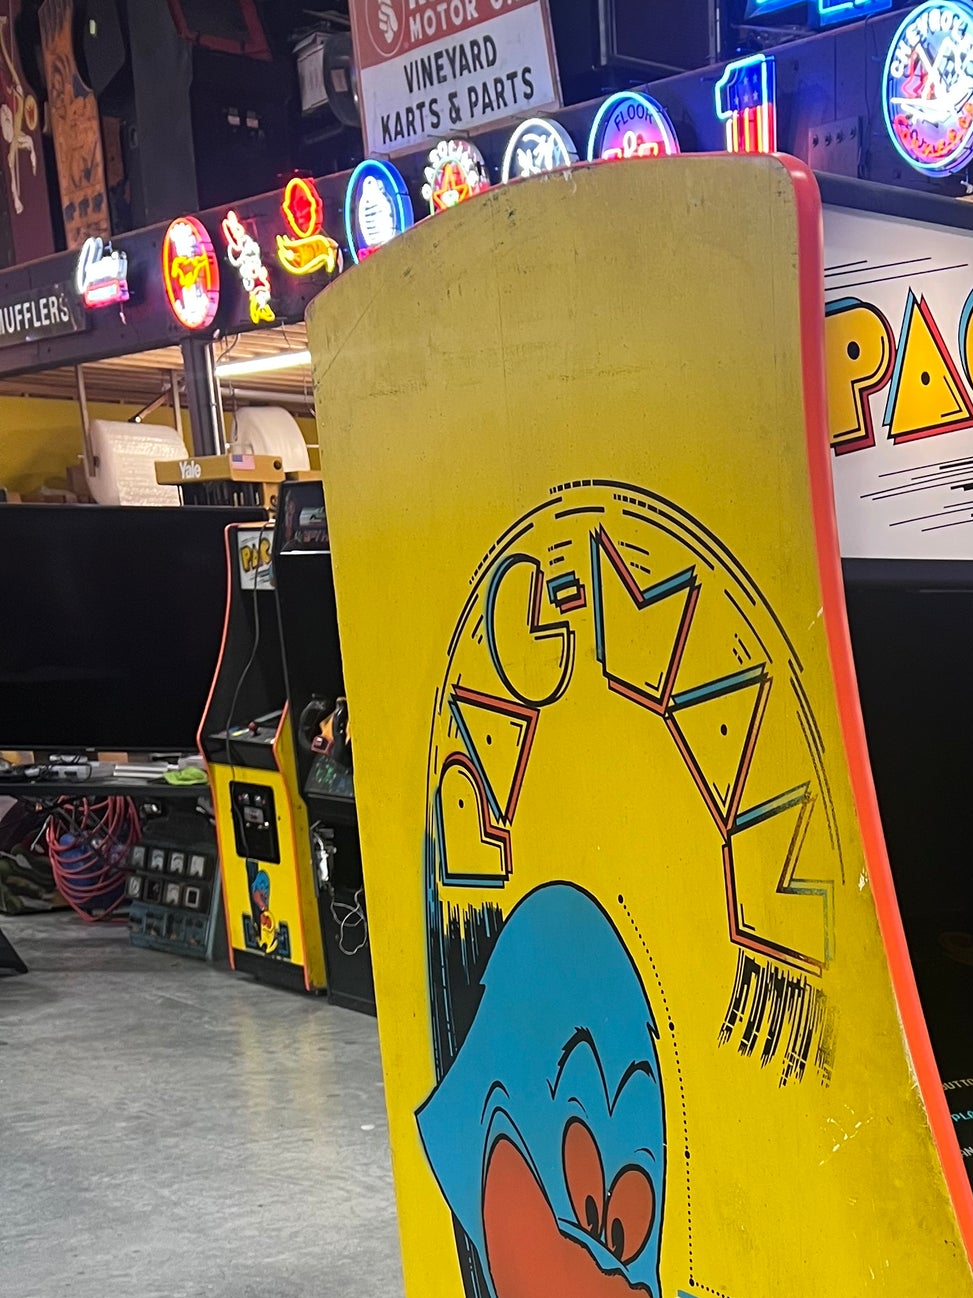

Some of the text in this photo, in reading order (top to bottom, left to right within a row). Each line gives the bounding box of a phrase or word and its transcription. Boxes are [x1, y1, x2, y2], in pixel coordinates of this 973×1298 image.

[409, 0, 479, 43] MOTOR
[403, 34, 498, 94] VINEYARD
[381, 66, 535, 145] KARTS & PARTS
[0, 295, 70, 337] UFFLERS
[179, 460, 202, 480] Yale
[434, 523, 836, 980] PAC-MAN
